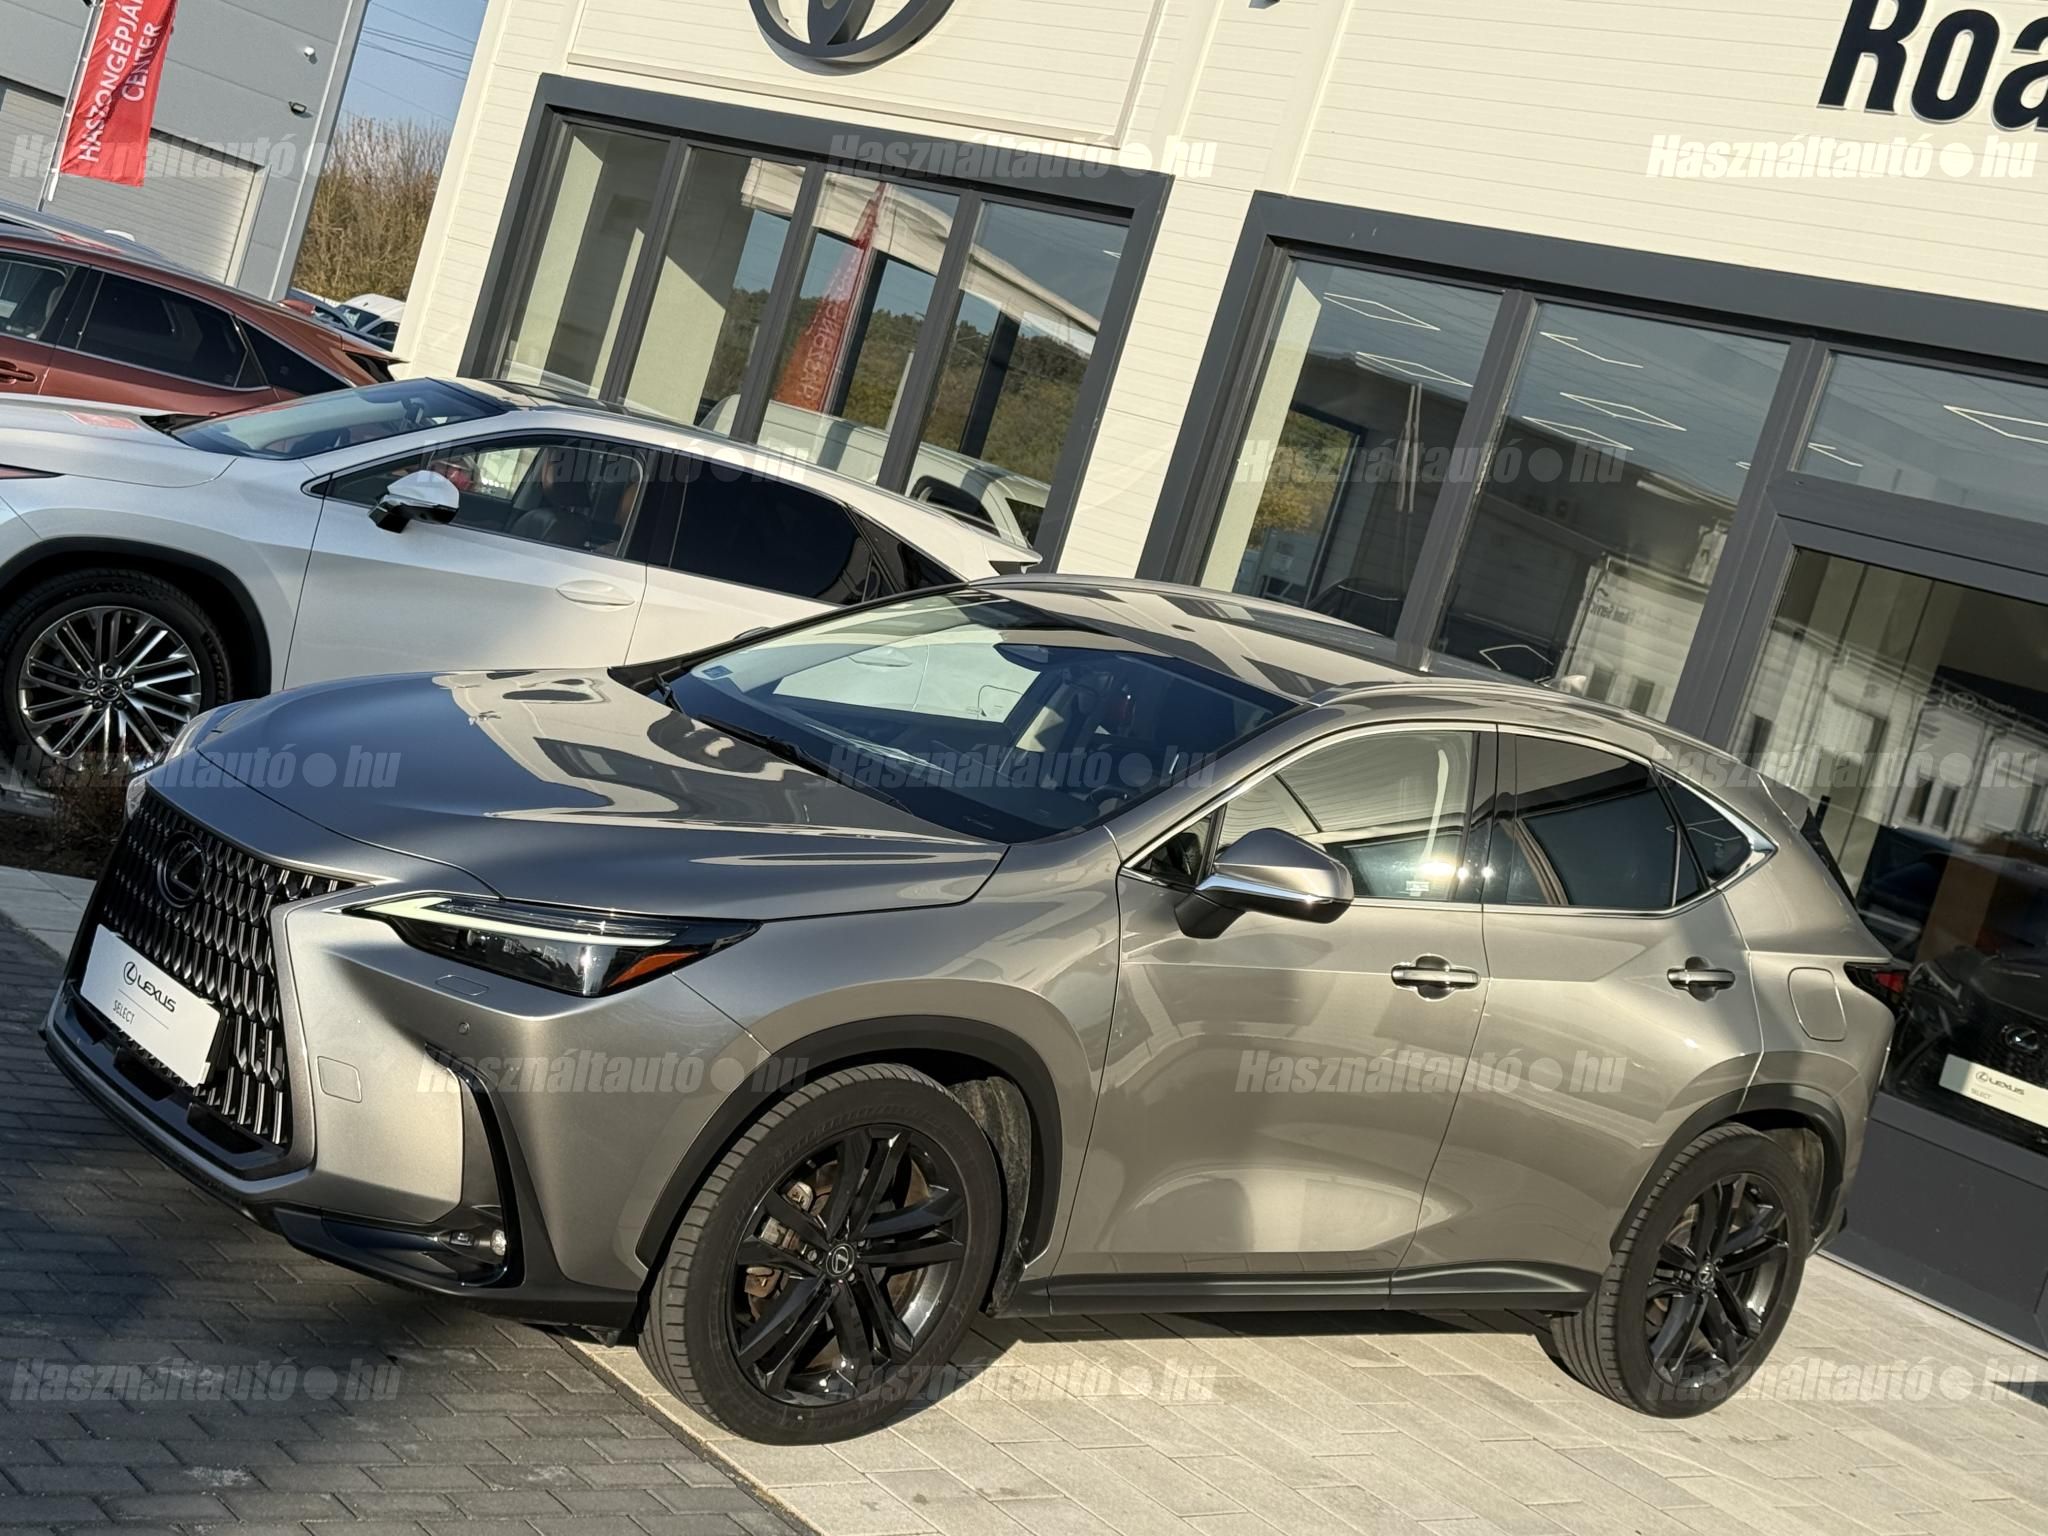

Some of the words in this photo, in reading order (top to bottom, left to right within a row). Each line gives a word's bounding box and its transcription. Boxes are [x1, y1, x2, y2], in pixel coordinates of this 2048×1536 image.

[121, 22, 161, 101] CENTER
[78, 0, 144, 162] HASZONGÉPJÁ
[137, 973, 177, 1013] LEXUS
[112, 1000, 135, 1025] SELECT
[1970, 1087, 1992, 1101] SELECT
[1988, 1077, 2026, 1096] LEXUS
